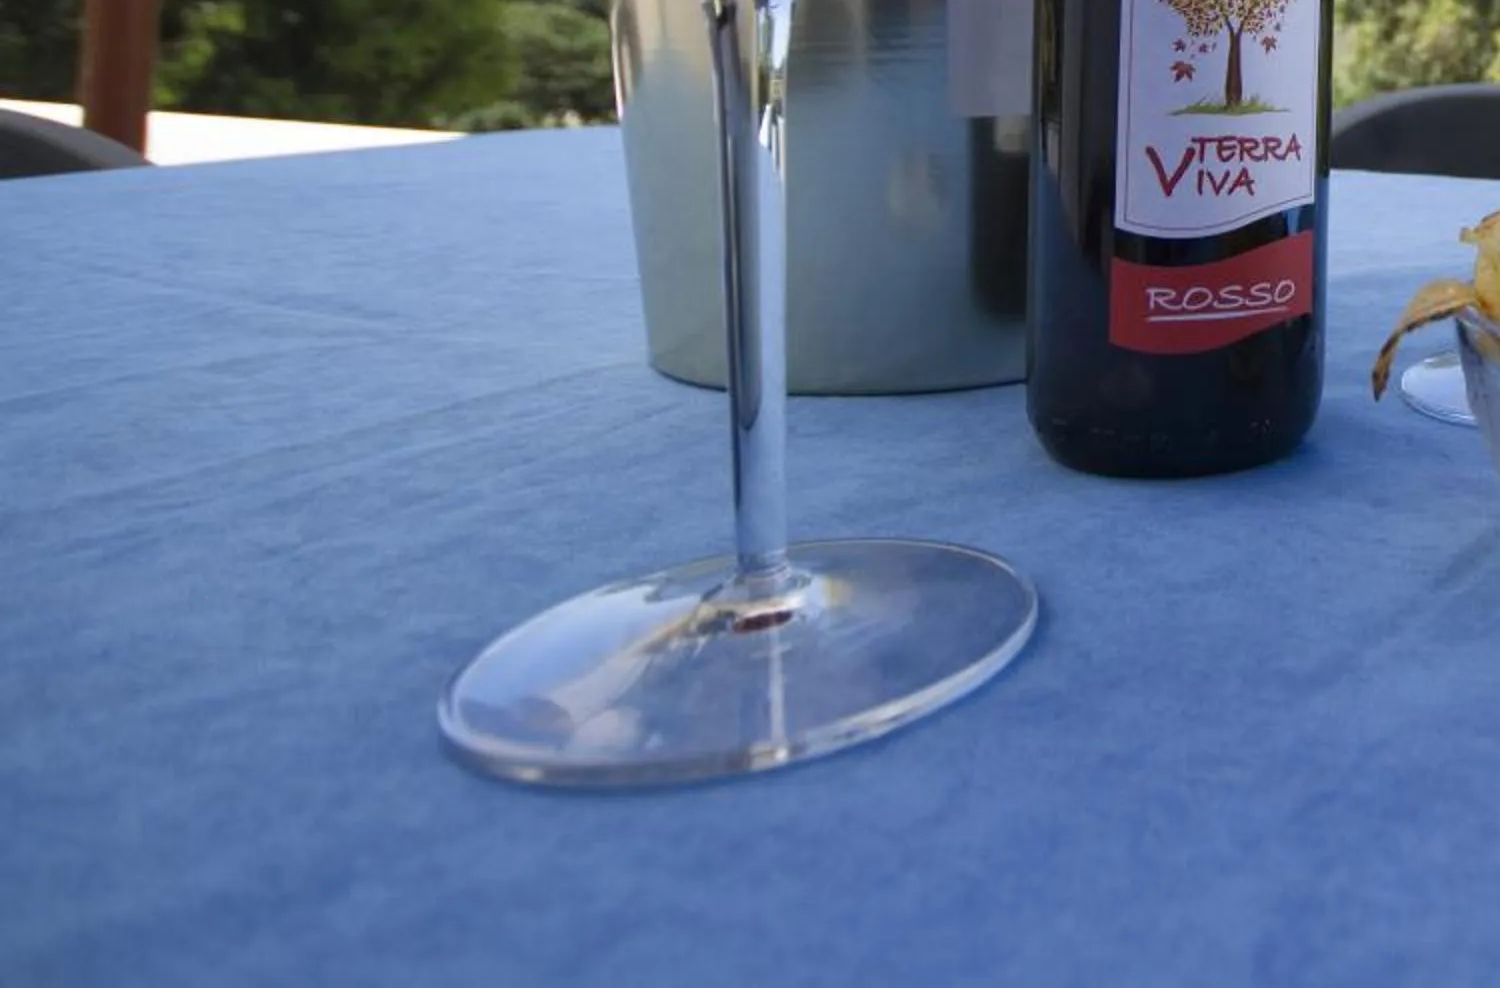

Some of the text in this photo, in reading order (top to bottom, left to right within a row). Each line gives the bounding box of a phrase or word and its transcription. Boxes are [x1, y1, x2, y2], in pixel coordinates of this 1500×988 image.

[1191, 133, 1302, 163] TERRA
[1146, 146, 1256, 197] VIVA
[1146, 279, 1295, 310] ROSSO
